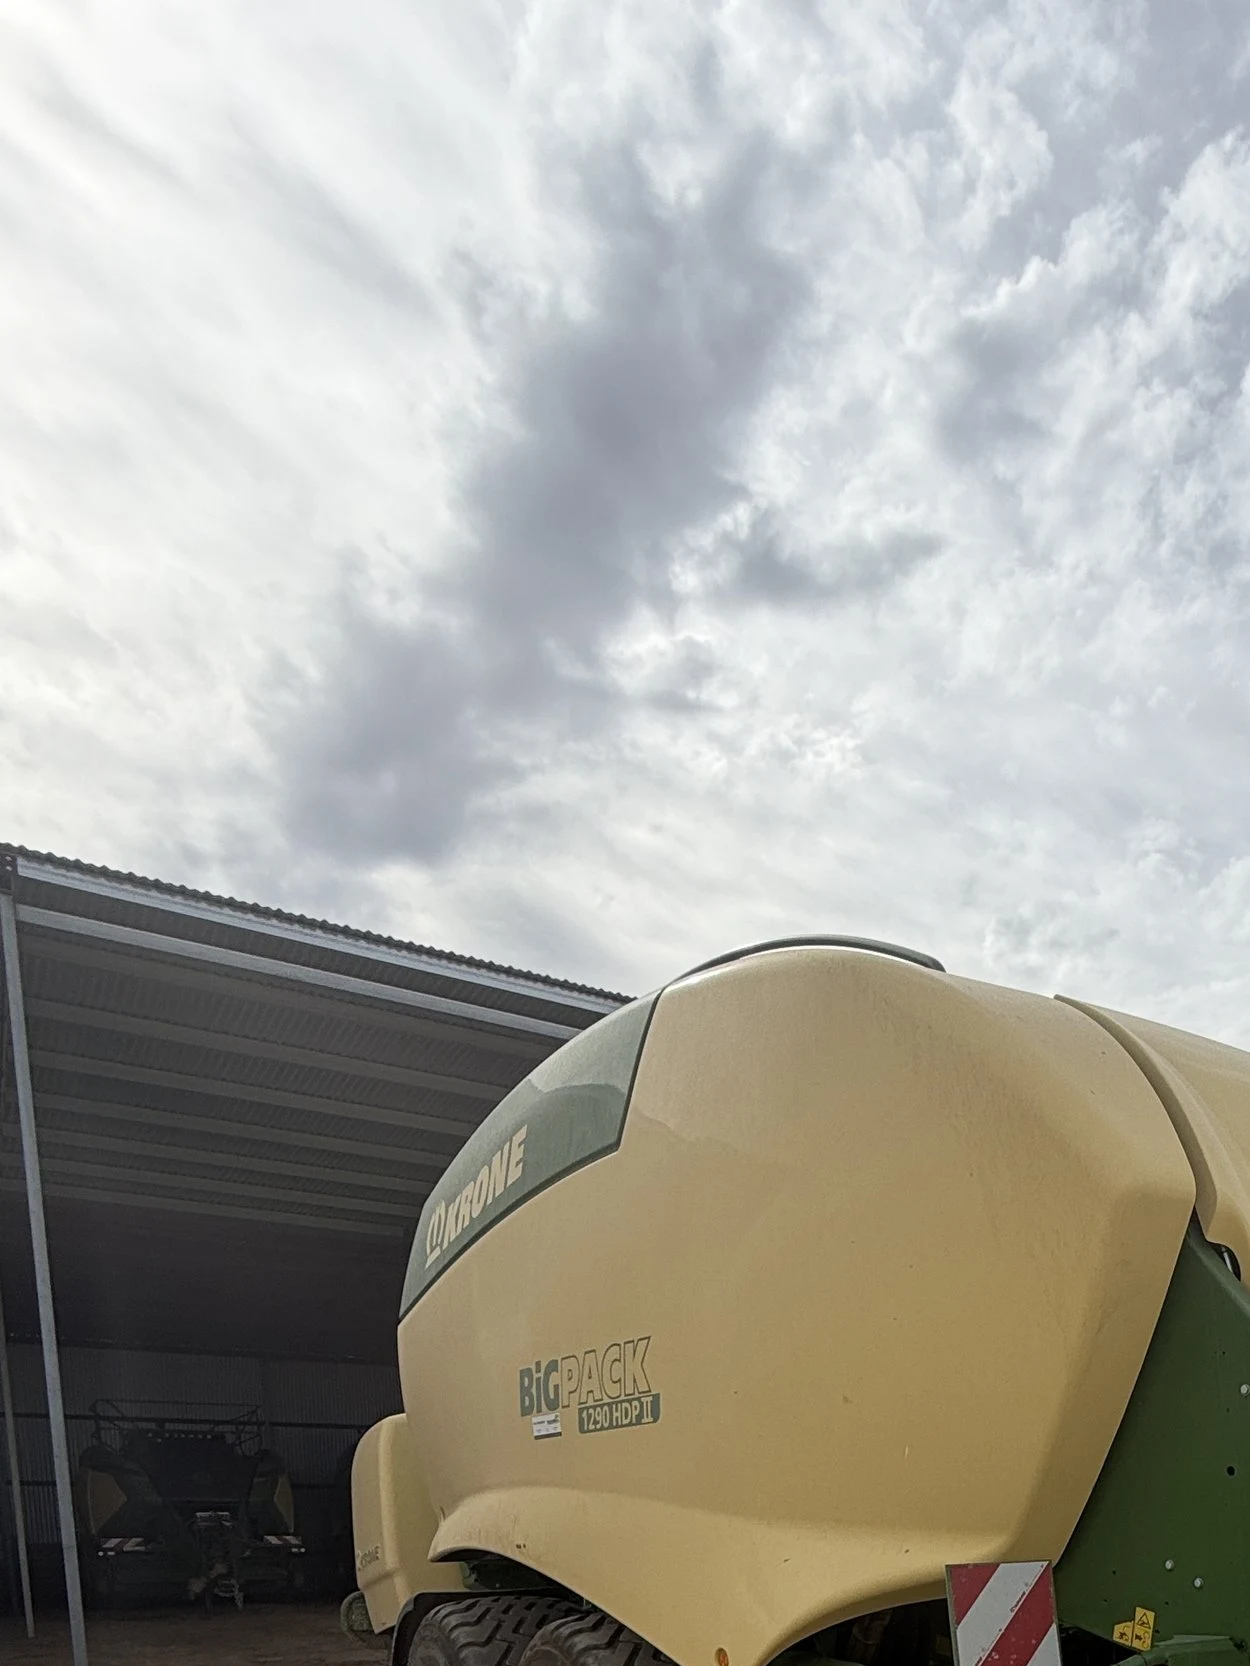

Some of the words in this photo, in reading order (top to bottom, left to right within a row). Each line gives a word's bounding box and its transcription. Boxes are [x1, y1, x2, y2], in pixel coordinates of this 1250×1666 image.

[442, 1124, 527, 1251] KRONE
[582, 1406, 610, 1431] 1290
[612, 1400, 640, 1427] HDP
